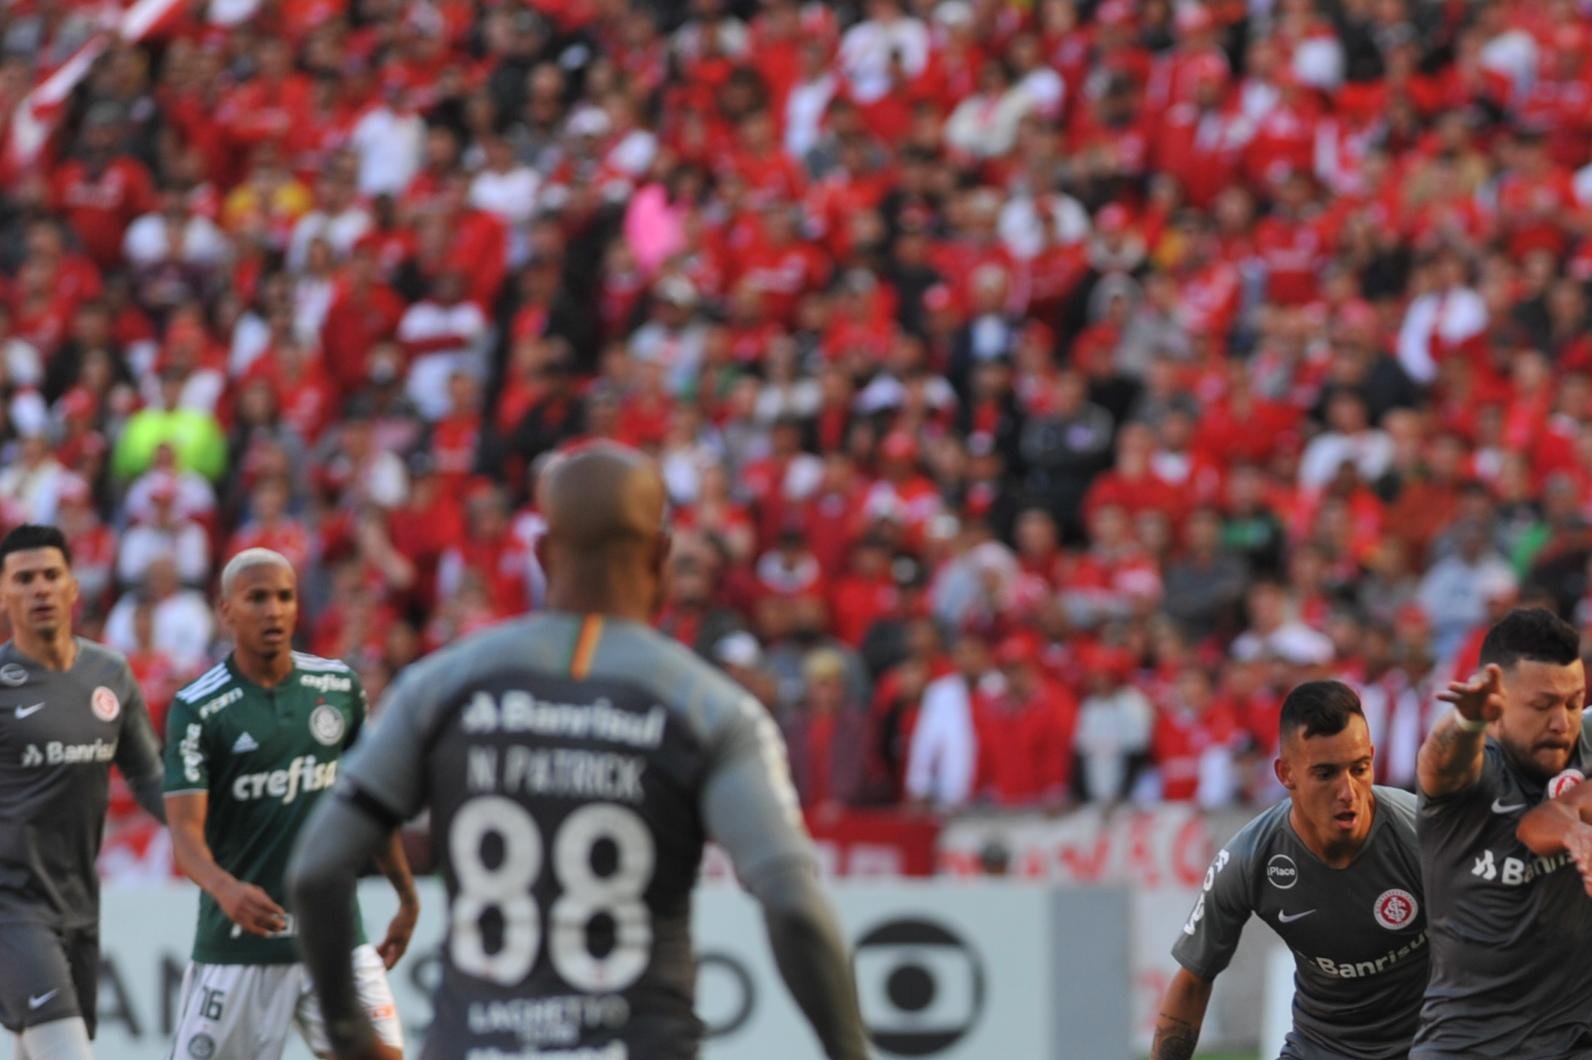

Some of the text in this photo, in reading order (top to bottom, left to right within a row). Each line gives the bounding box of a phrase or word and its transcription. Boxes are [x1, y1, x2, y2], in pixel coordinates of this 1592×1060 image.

[504, 745, 647, 801] PATRICK
[448, 797, 656, 991] 88
[1267, 865, 1296, 877] iPlace
